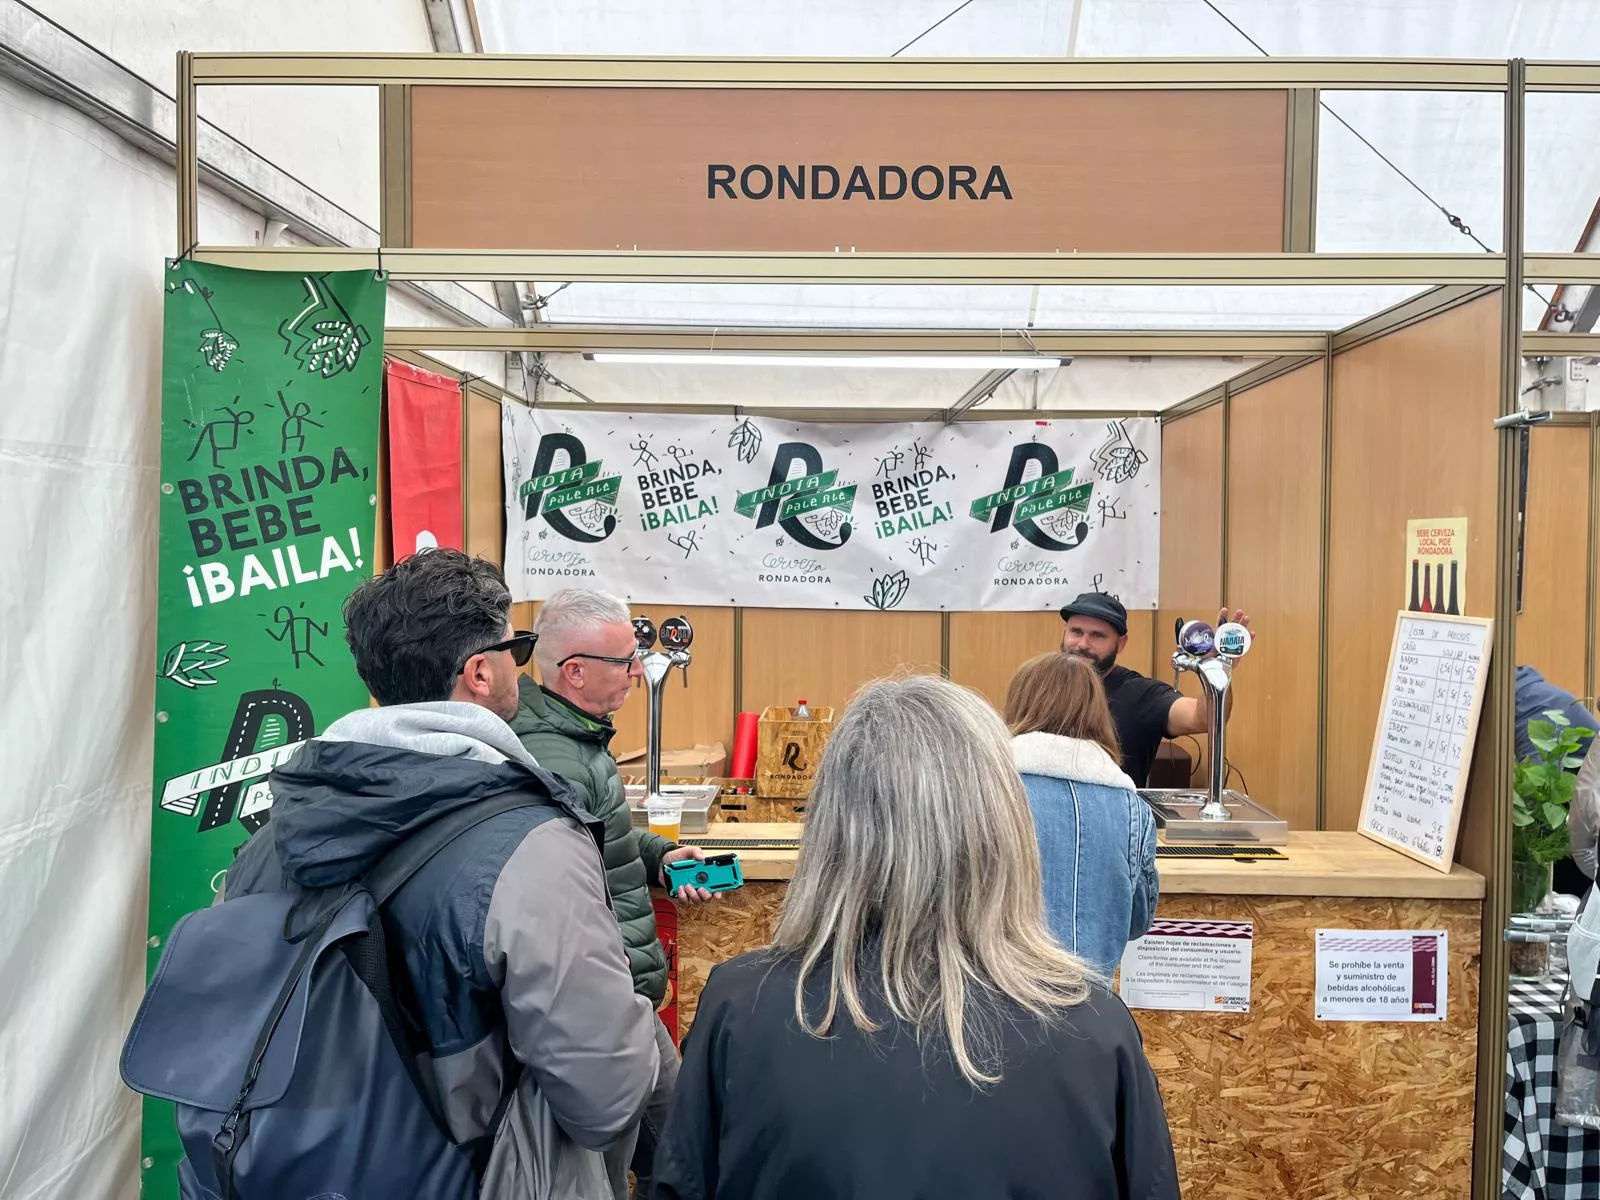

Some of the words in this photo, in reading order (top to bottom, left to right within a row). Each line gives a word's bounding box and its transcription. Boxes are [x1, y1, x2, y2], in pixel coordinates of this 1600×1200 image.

[707, 164, 1013, 201] RONDADORA
[178, 446, 369, 515] BRINDA,
[523, 467, 584, 495] INDIA
[637, 459, 722, 491] BRINDA,
[871, 464, 956, 500] BRINDA,
[641, 482, 698, 510] BEBE
[751, 476, 820, 503] INDIA
[876, 488, 933, 518] BEBE
[986, 475, 1056, 507] INDIA
[188, 494, 321, 558] BEBE
[639, 495, 720, 532] ¡BAILA!
[875, 501, 954, 540] ¡BAILA!
[1430, 528, 1455, 537] CERVEZA
[528, 545, 591, 568] Cerveza
[762, 552, 826, 575] Cerveza
[1417, 546, 1454, 555] RONDADORA
[182, 527, 364, 608] ¡BAILA!
[758, 574, 832, 585] RONDADORA
[997, 556, 1063, 576] Cerveza
[994, 576, 1069, 586] RONDADORA
[1328, 961, 1339, 969] Se
[1373, 961, 1381, 969] la
[1383, 961, 1405, 969] venta
[1343, 973, 1385, 981] suministro
[1387, 973, 1397, 981] de
[1327, 984, 1359, 992] bebidas
[1360, 984, 1405, 992] alcohólicas
[1379, 996, 1388, 1004] 18
[1390, 996, 1409, 1004] años
